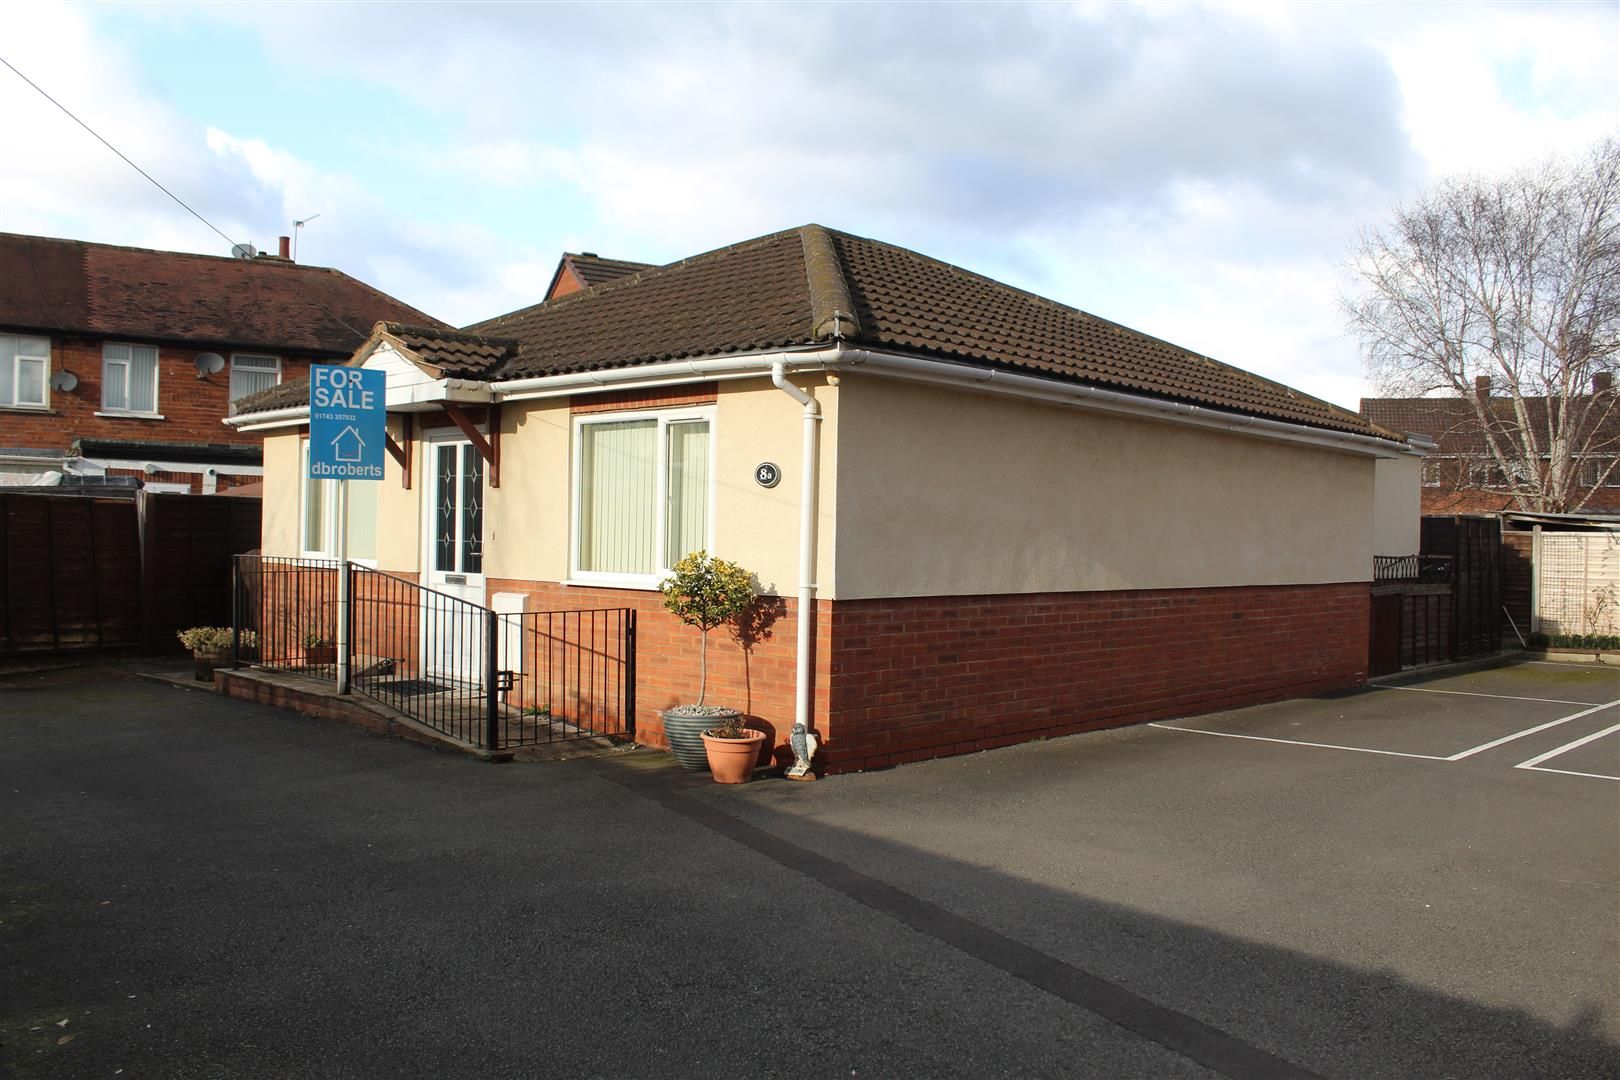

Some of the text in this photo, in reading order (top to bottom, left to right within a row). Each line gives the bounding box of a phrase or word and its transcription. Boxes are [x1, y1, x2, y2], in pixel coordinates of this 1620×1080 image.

[315, 368, 363, 390] FOR
[315, 388, 374, 410] SALE
[312, 461, 382, 476] dbroberts
